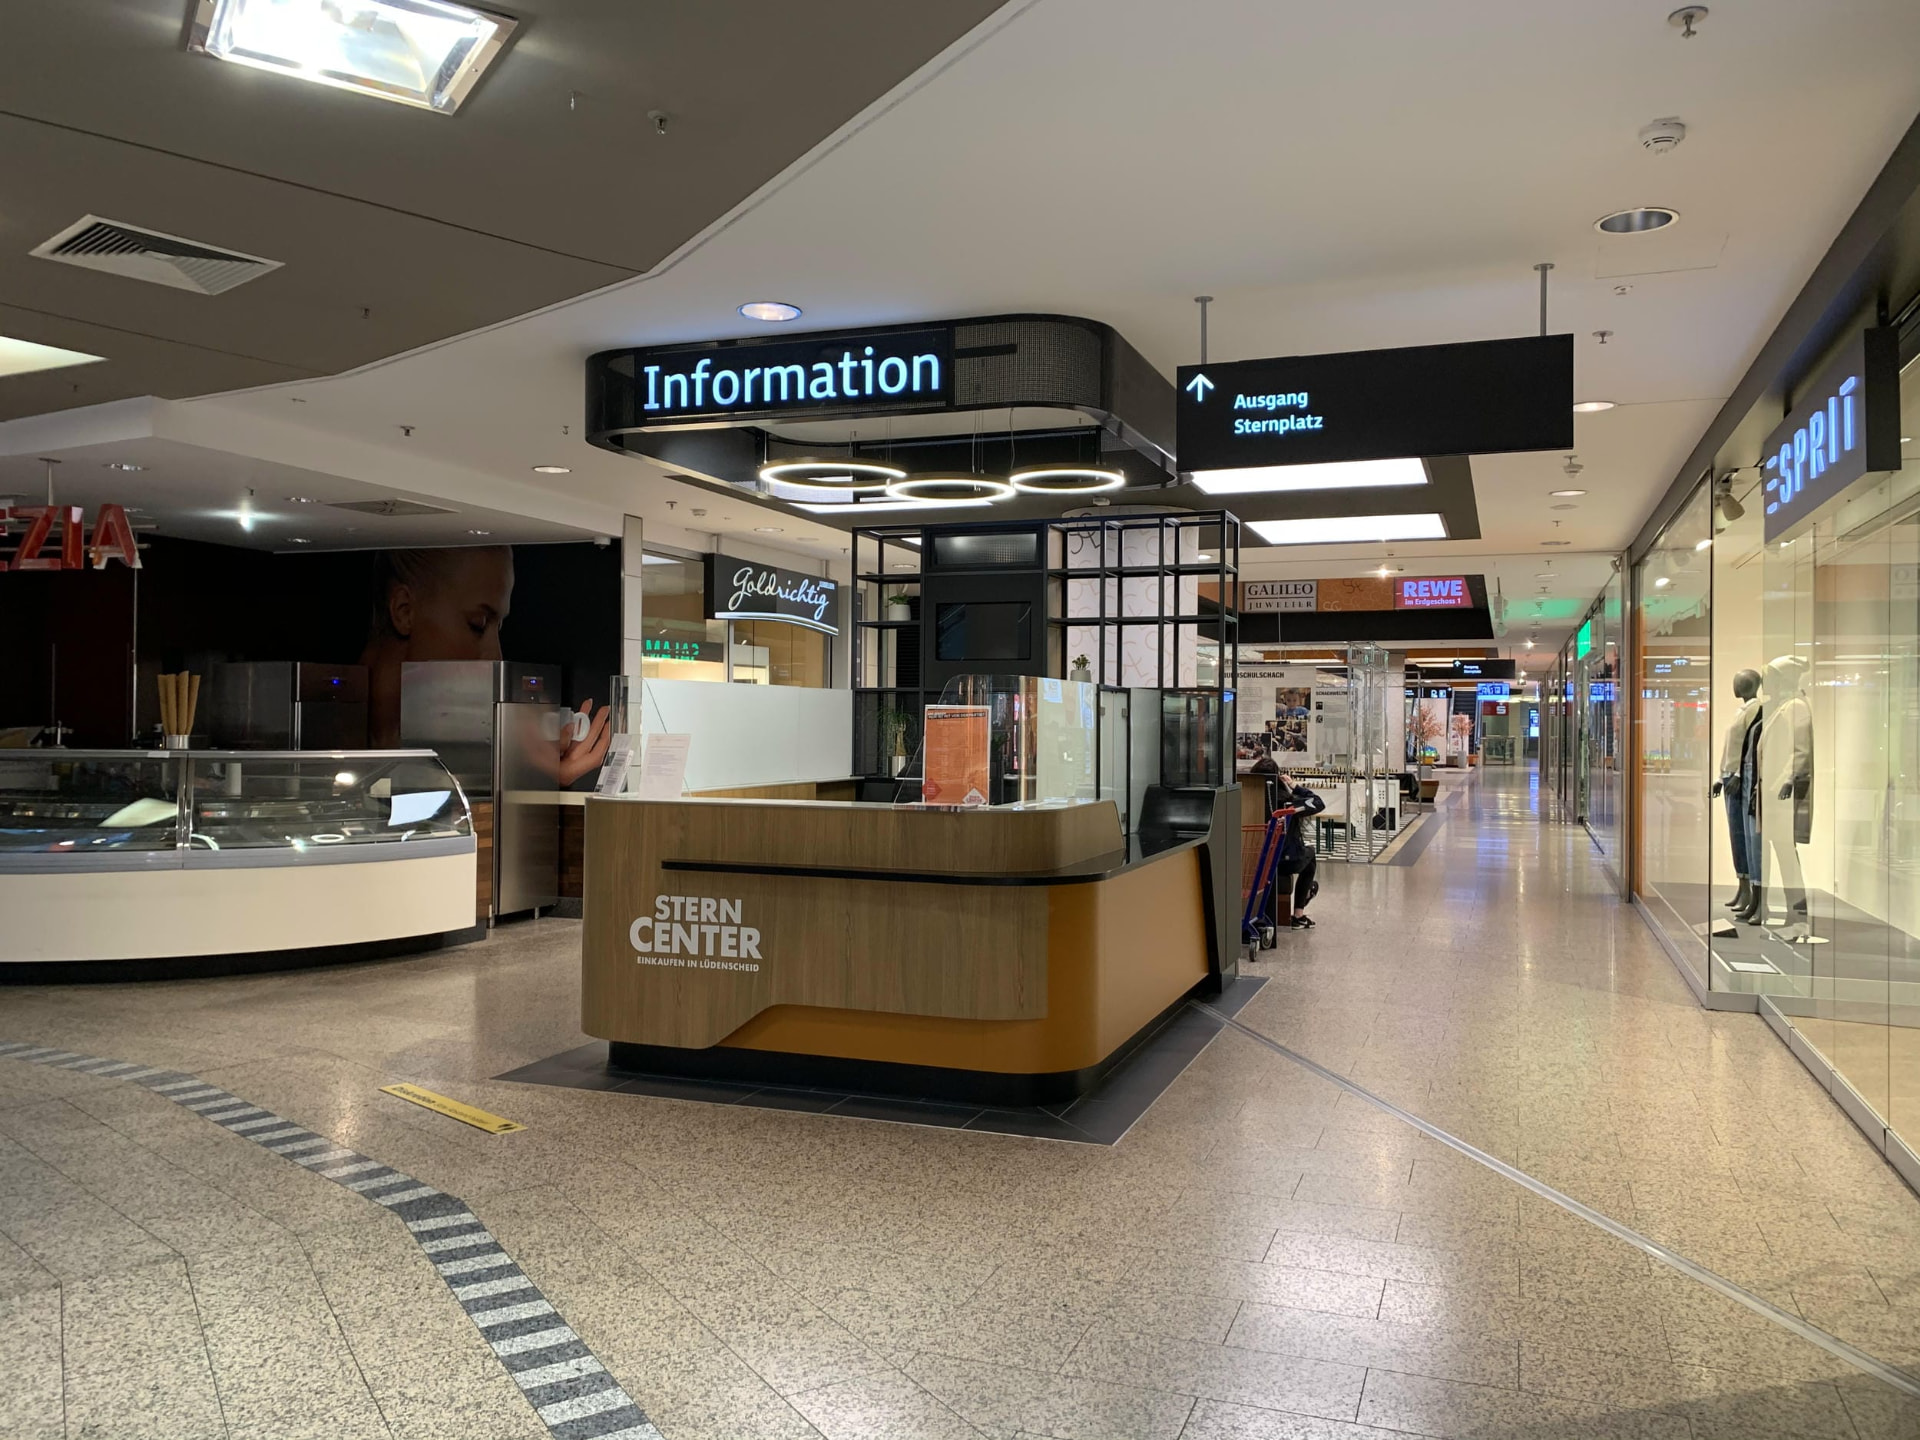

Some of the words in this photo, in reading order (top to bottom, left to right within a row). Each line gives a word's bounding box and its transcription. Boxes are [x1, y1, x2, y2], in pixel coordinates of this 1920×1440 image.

[643, 346, 940, 410] Information
[1234, 391, 1309, 411] Ausgang
[1234, 414, 1323, 434] Sternplatz
[1766, 376, 1857, 514] ESPRIT
[728, 567, 830, 620] Goldrichtig
[1247, 583, 1314, 597] GALILEO
[1403, 580, 1463, 597] REWE
[1249, 600, 1313, 611] JUWELIER
[1415, 597, 1455, 607] Erdgeschoss
[654, 894, 742, 924] STERN
[629, 916, 763, 960] CENTER
[637, 956, 685, 967] EINKAUFEN
[687, 959, 698, 968] IN
[700, 959, 760, 972] LÜDENSCHEID
